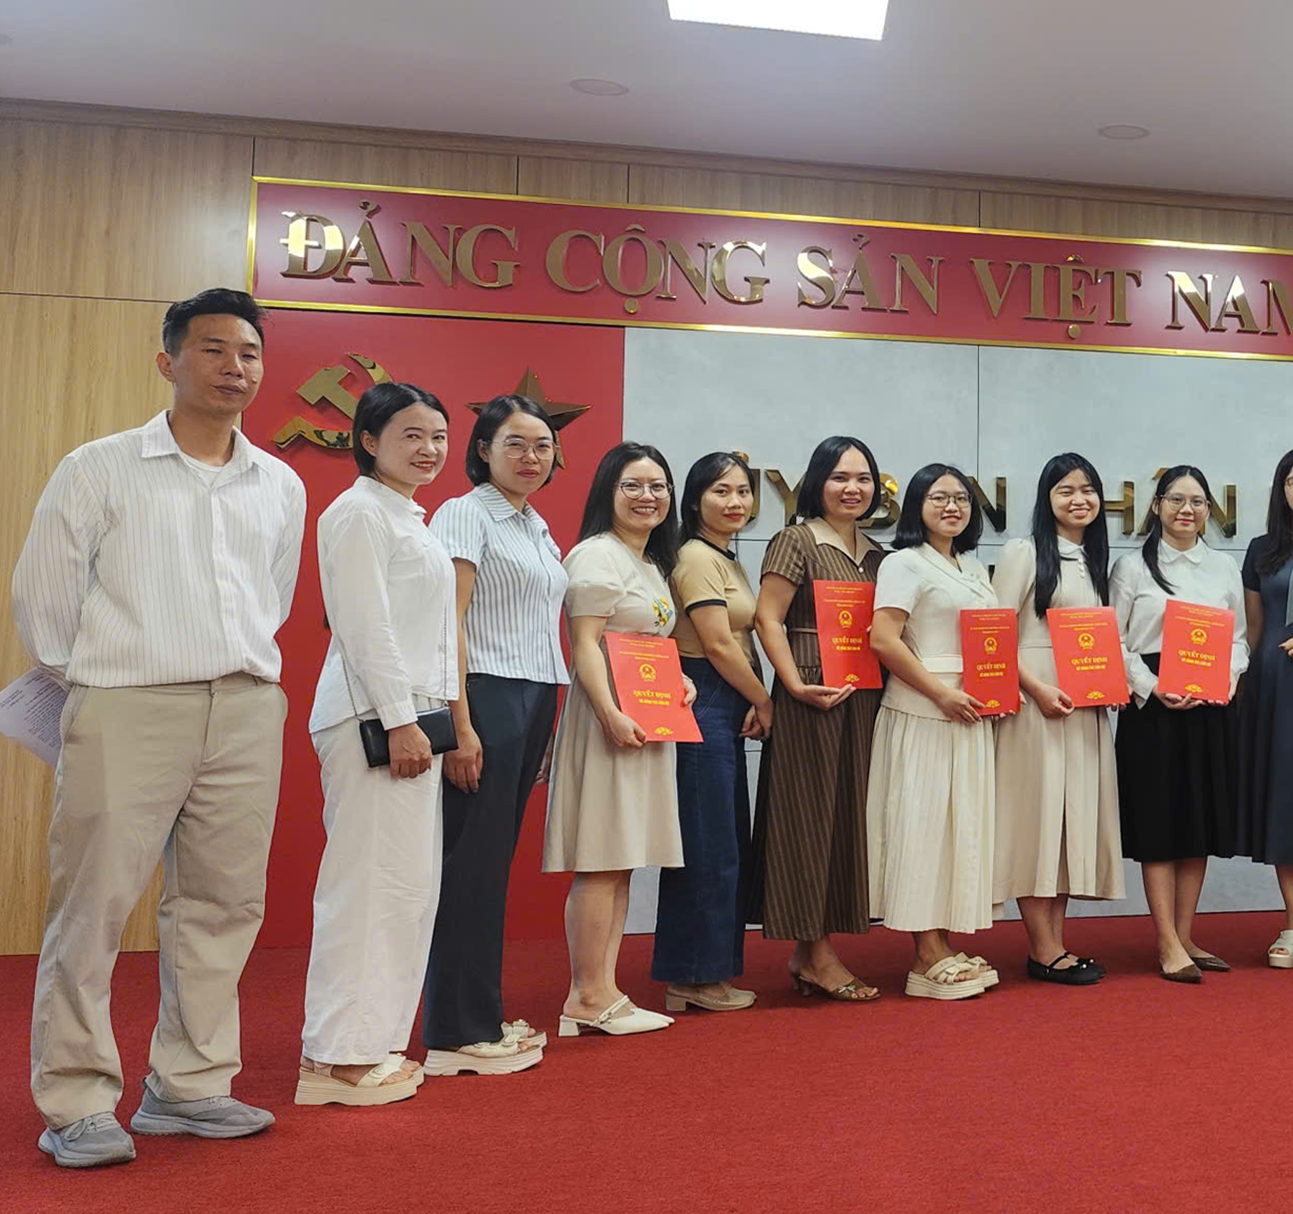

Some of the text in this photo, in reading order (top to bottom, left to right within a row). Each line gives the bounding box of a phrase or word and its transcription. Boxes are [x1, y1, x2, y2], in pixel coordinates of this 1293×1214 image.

[279, 200, 518, 288] ĐẢNG
[545, 224, 771, 315] CỘNG
[797, 233, 943, 316] SẢN
[971, 253, 1142, 340] VIỆT
